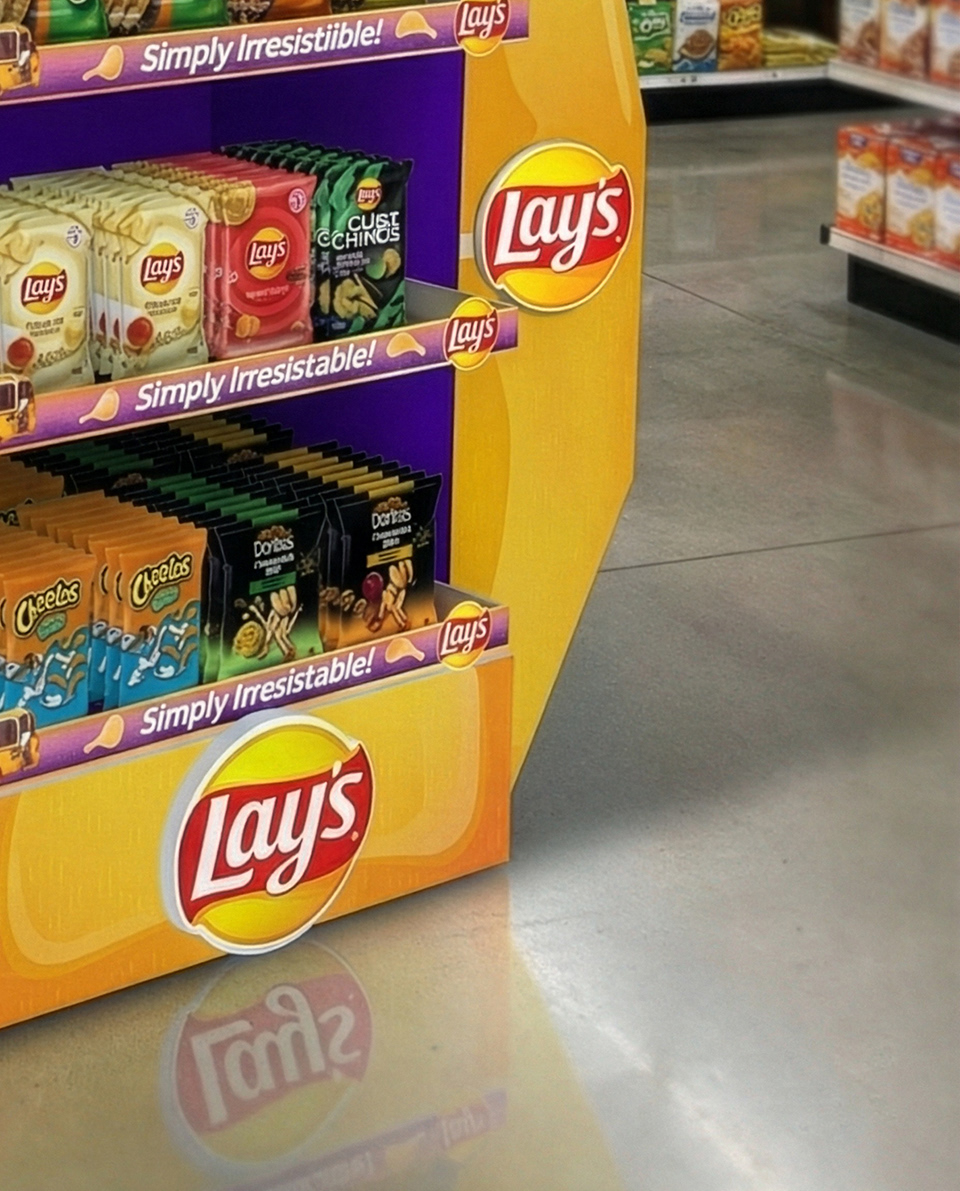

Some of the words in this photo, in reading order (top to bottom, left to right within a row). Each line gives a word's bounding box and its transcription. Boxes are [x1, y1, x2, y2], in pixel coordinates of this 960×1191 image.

[140, 35, 235, 76] Simply
[493, 176, 624, 273] Lay's
[135, 371, 227, 411] Simply
[229, 339, 377, 394] Irresistable!
[139, 690, 230, 735] Simply
[232, 646, 377, 711] Irresistable!
[190, 760, 364, 901] Lay's
